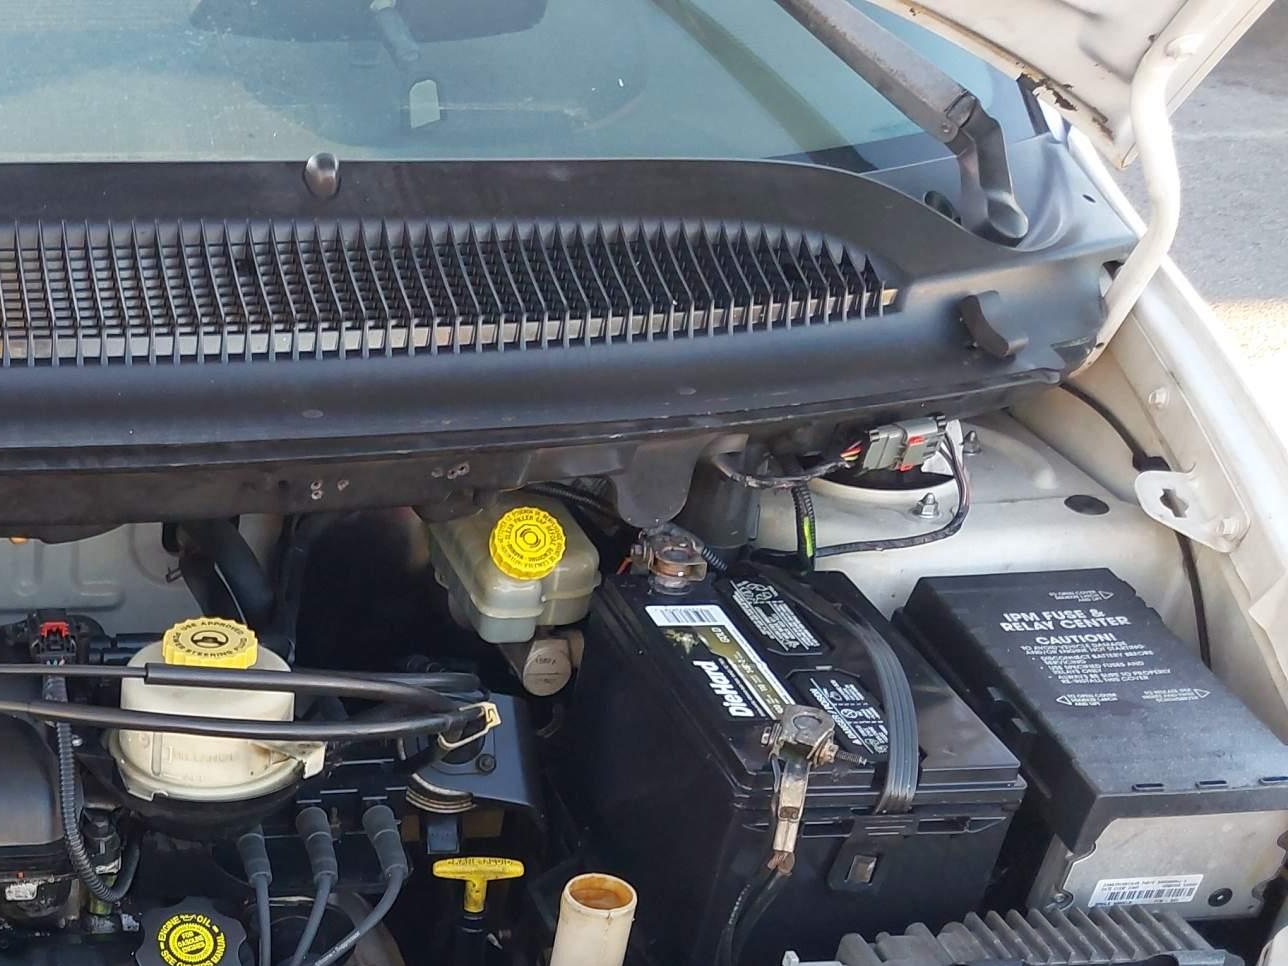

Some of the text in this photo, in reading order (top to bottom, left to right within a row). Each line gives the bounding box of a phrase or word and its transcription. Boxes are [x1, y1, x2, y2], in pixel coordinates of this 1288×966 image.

[1000, 616, 1132, 632] RELAY CENTER
[1003, 608, 1106, 623] IPM FUSE &
[1035, 633, 1117, 646] CAUTION!
[693, 660, 756, 719] DieHard
[158, 914, 213, 942] ENGINE OIL
[160, 949, 178, 966] SEE
[210, 932, 227, 964] MANUAL
